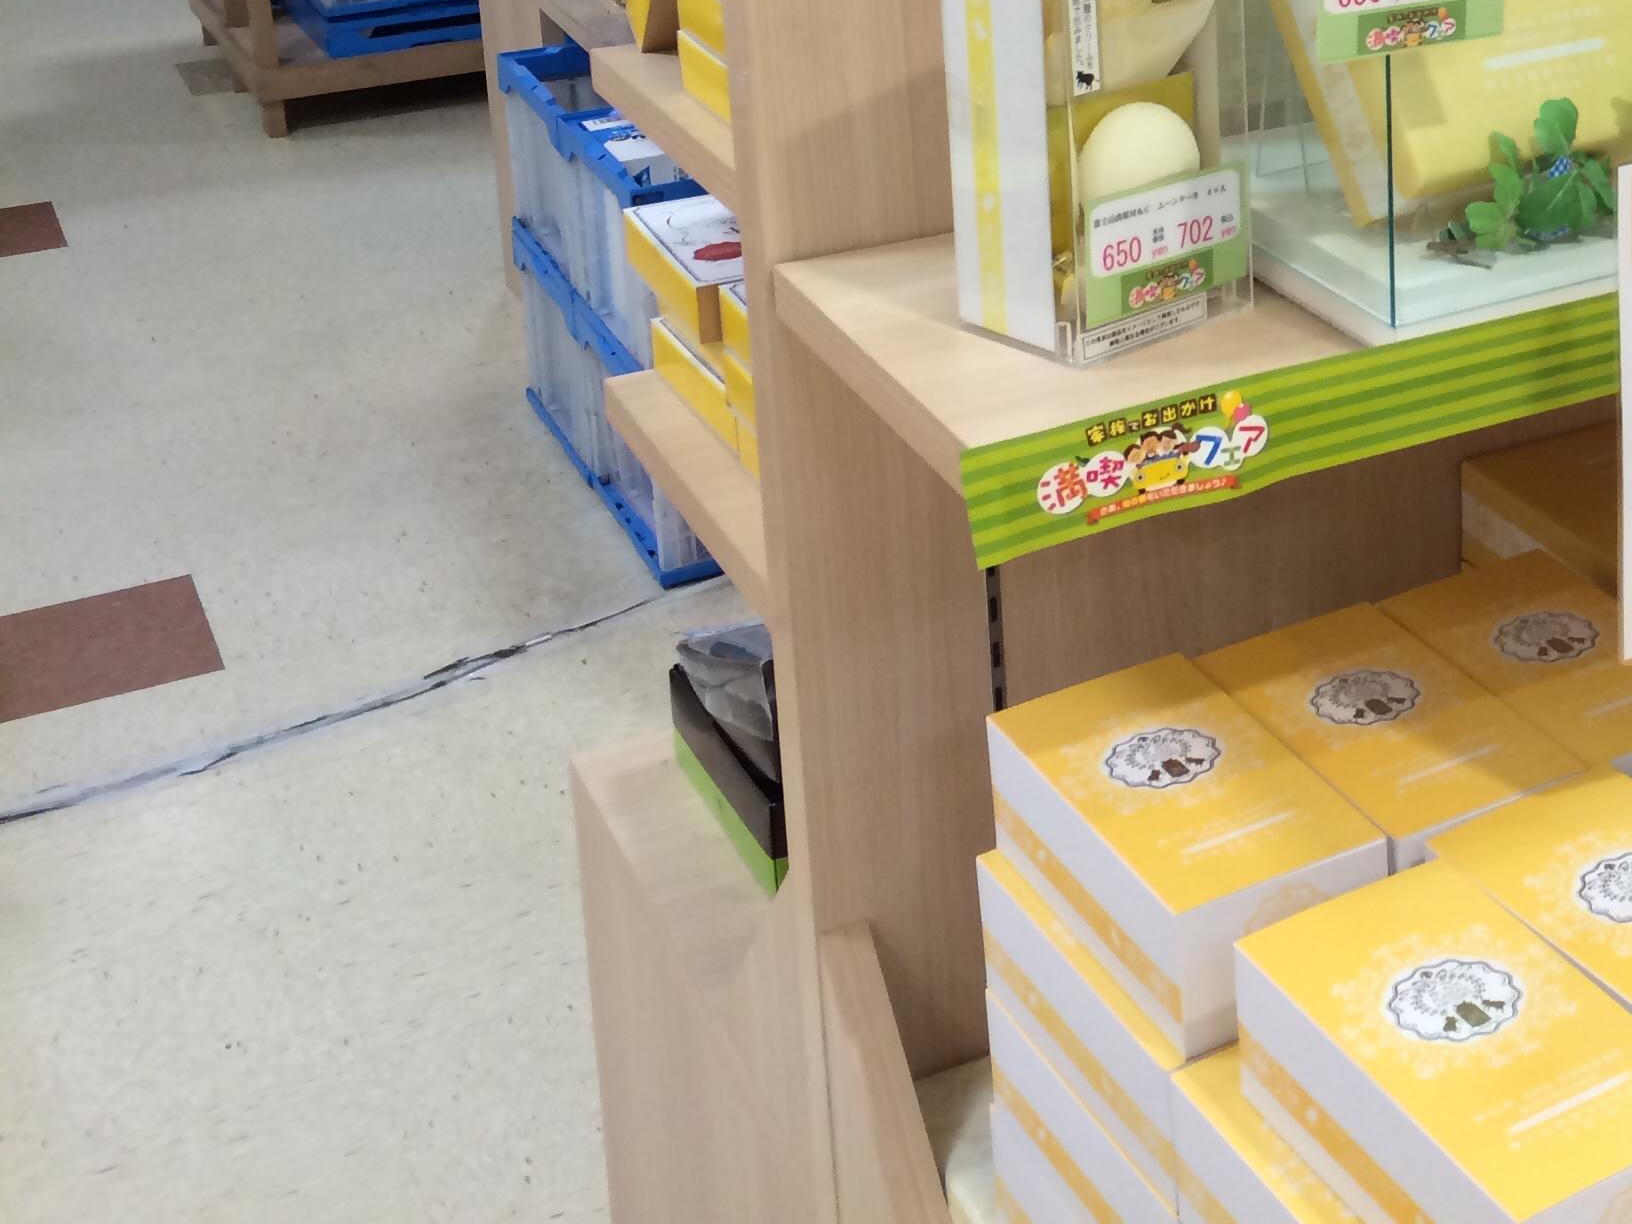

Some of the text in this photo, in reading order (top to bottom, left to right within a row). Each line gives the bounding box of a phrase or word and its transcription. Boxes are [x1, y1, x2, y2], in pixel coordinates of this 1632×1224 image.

[1177, 215, 1213, 248] 702
[1102, 236, 1142, 271] 650
[1087, 395, 1216, 445] 家族でお出かけ
[1041, 426, 1265, 510] 満喫フェア
